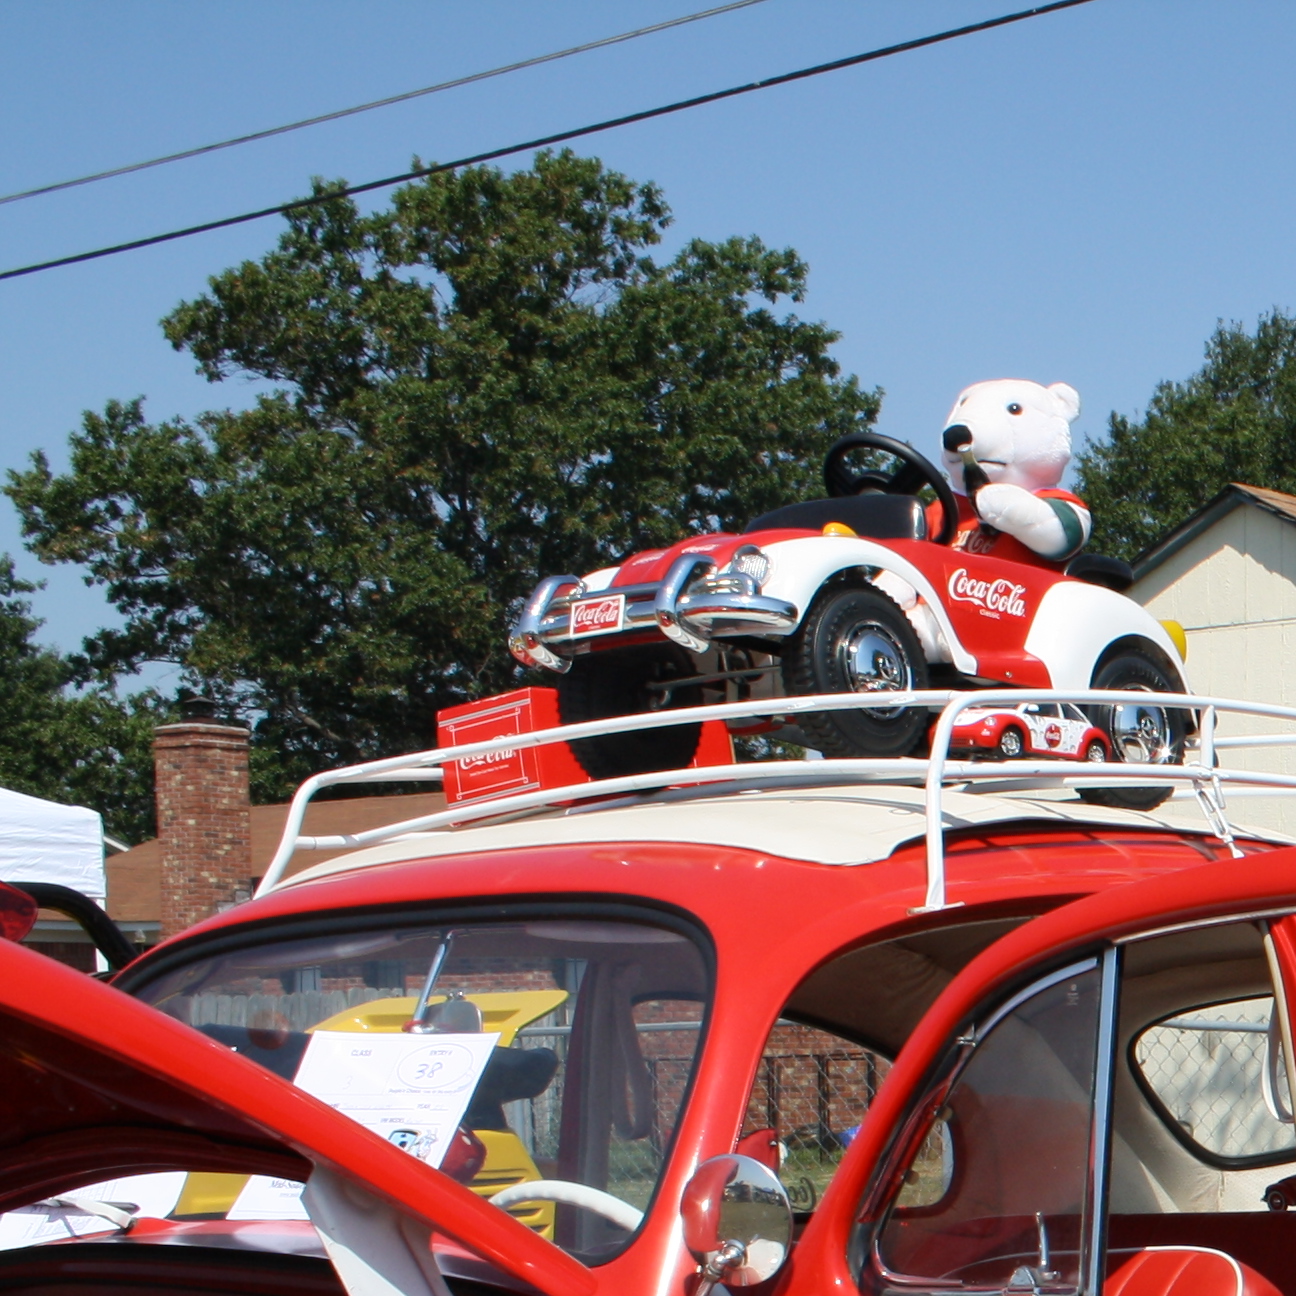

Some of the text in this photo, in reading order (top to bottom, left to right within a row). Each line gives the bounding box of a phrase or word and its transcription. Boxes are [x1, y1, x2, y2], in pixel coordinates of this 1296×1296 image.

[948, 567, 1026, 618] Coca-Cola
[574, 600, 620, 628] Coca-Cola
[414, 1061, 443, 1080] 38
